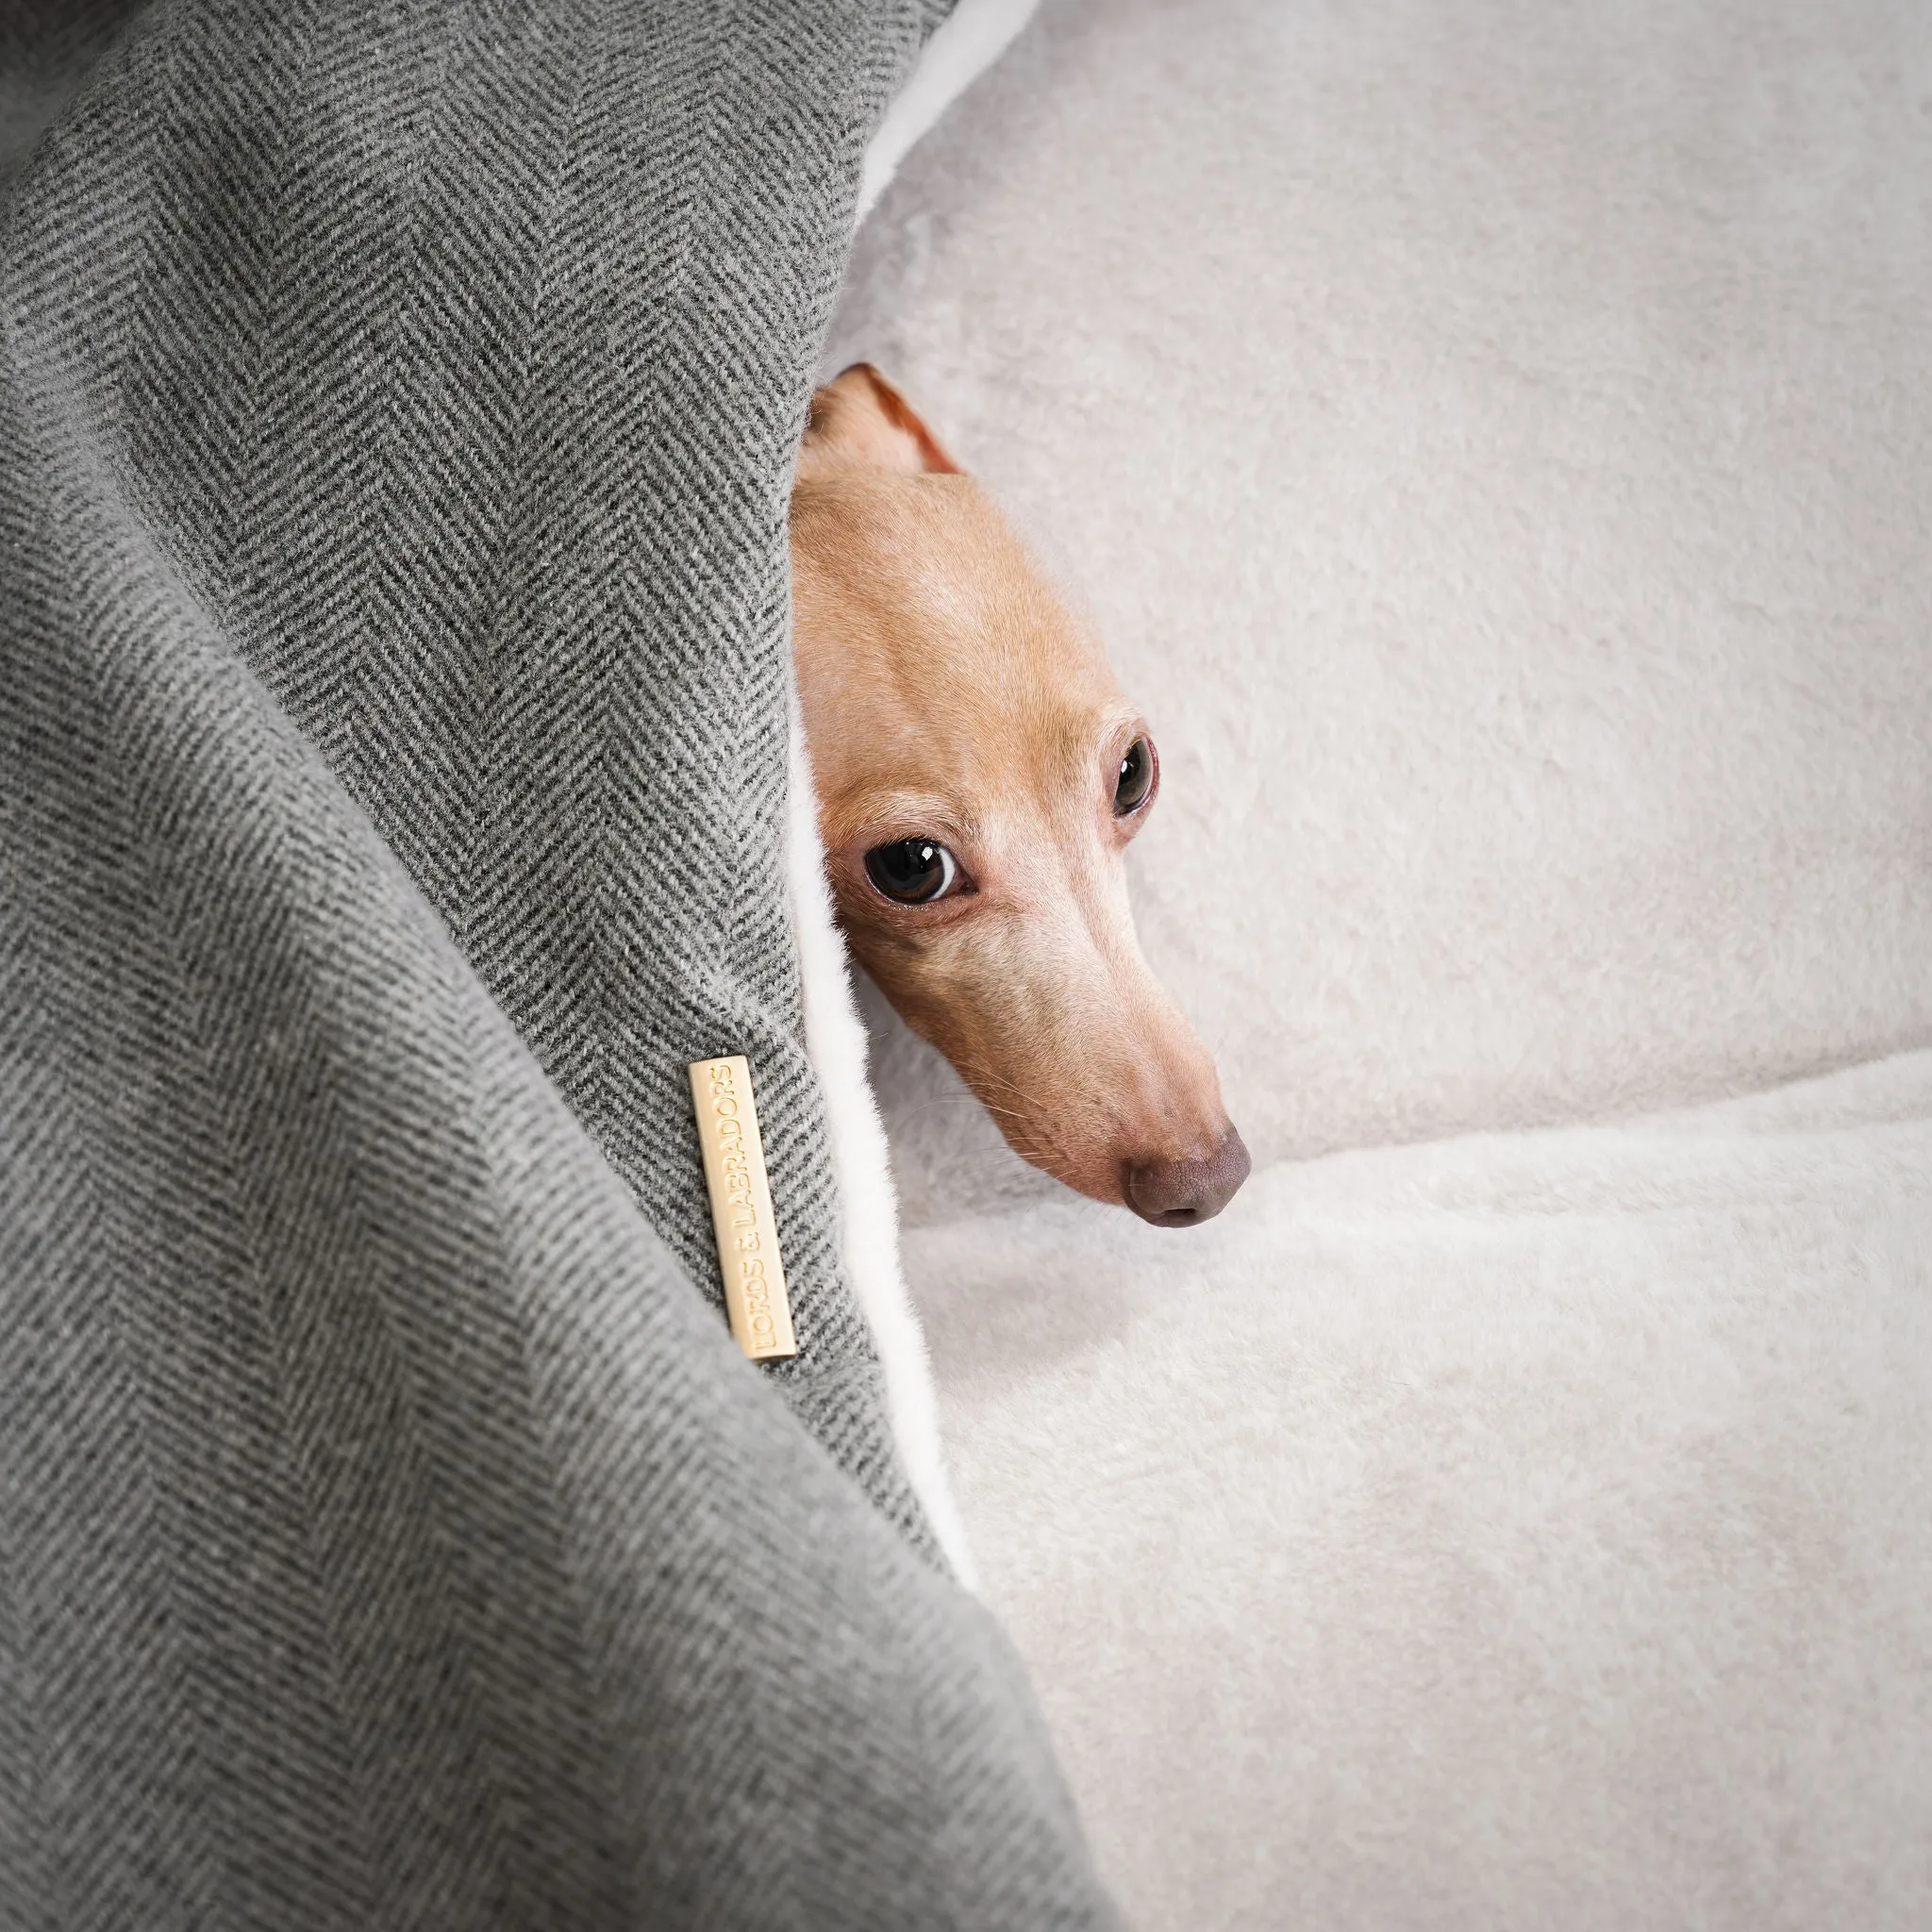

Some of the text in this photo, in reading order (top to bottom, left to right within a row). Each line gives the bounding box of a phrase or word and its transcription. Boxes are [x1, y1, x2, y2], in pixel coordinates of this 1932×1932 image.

[708, 1064, 776, 1350] LORDS & LABRADORS
